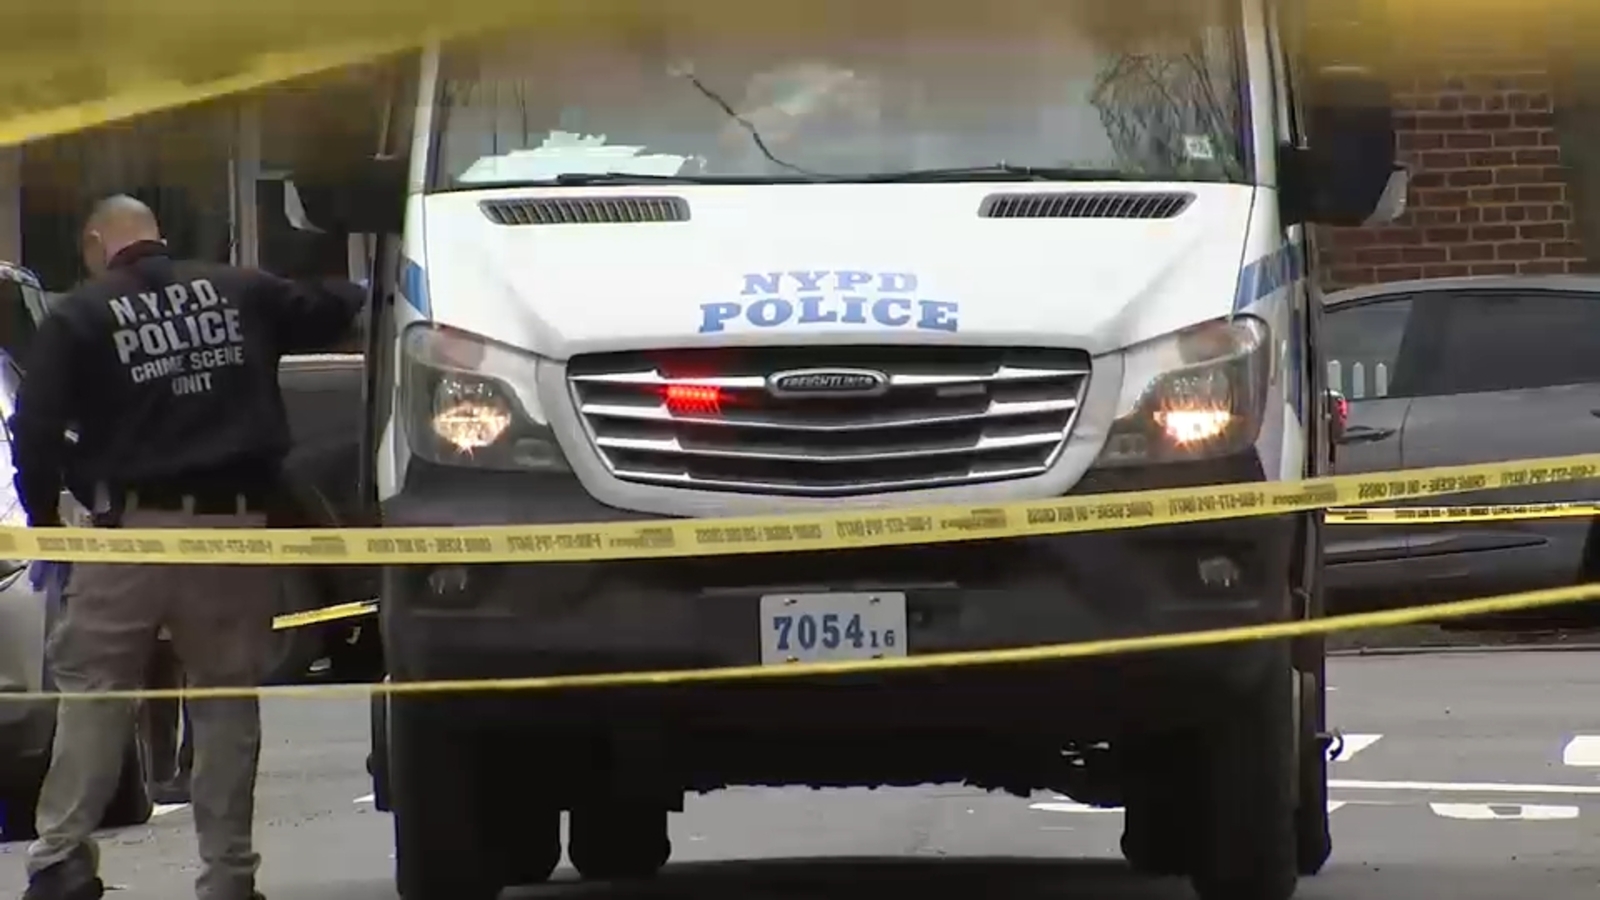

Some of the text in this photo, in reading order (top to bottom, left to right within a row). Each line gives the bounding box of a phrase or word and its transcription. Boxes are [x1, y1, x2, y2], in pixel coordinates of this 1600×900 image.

[740, 271, 919, 295] NYPD
[109, 279, 227, 326] N.Y.P.D.
[698, 297, 960, 333] POLICE
[113, 309, 244, 364] POLICE
[131, 347, 244, 383] CRIME SCENE
[172, 372, 212, 395] UNIT
[773, 613, 895, 650] 7054 16
